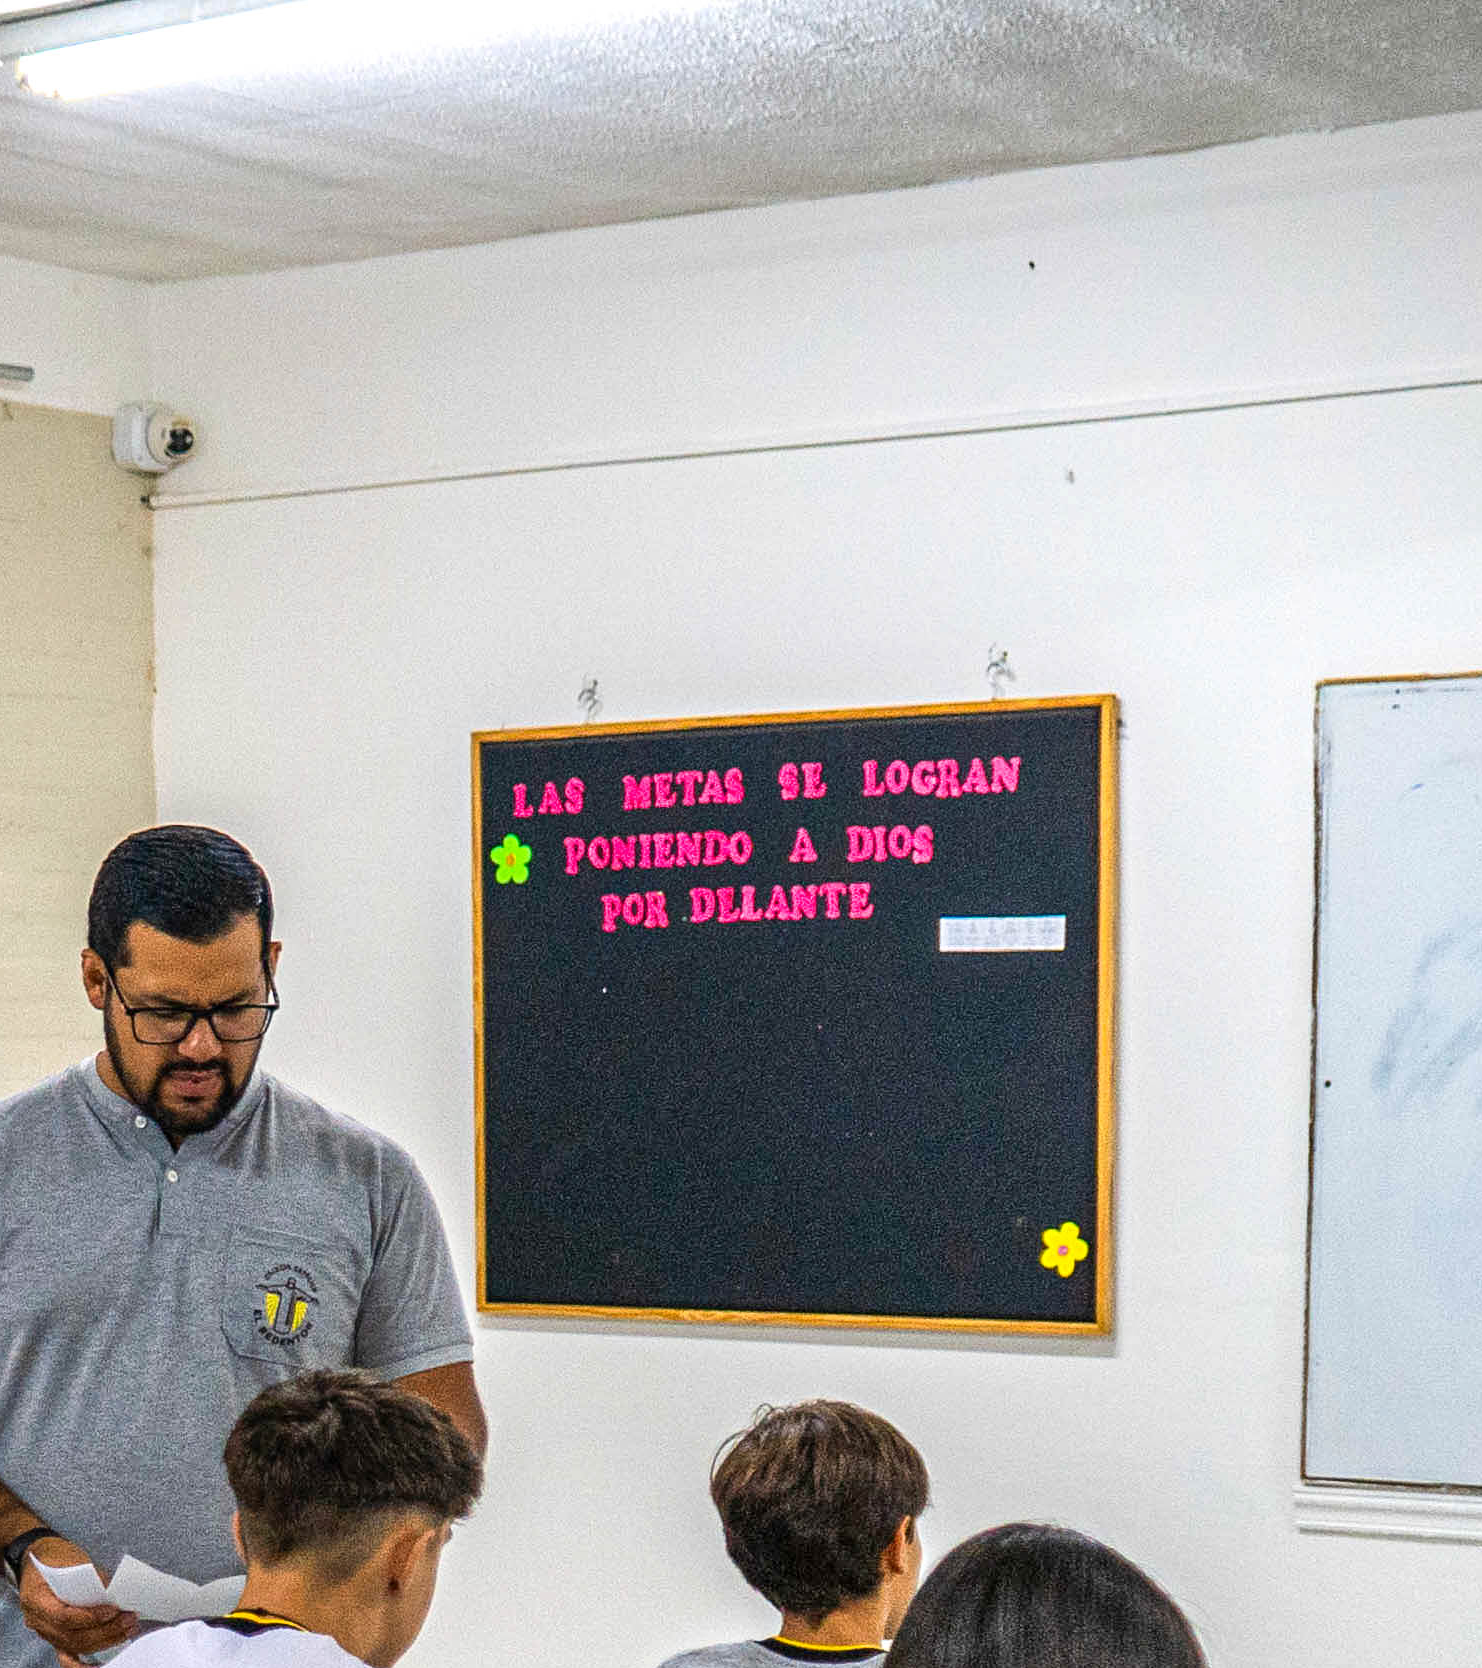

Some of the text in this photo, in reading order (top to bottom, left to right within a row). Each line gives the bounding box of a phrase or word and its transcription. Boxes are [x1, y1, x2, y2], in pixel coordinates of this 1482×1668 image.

[512, 755, 1023, 819] LAS METAS SE LOGRAN
[562, 824, 935, 876] PONIENDO A DIOS
[600, 890, 670, 934] POR
